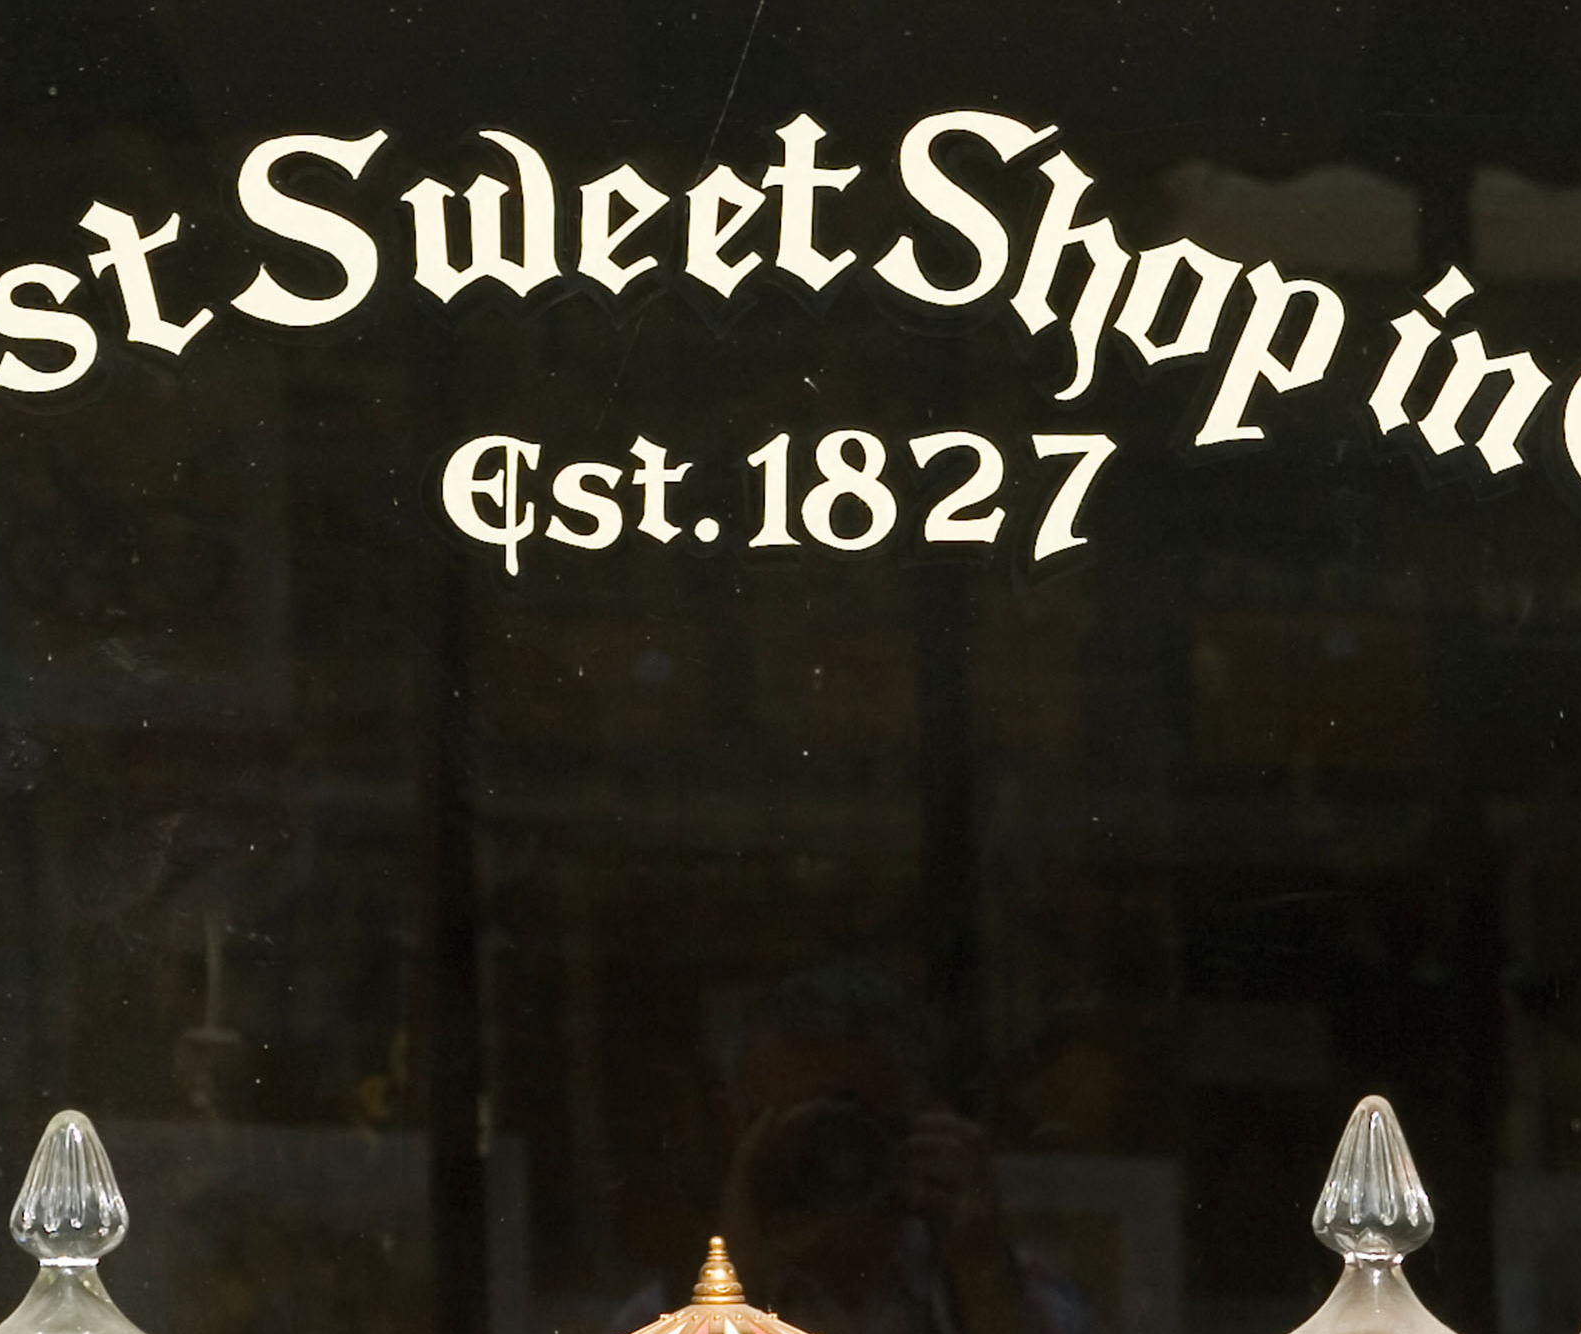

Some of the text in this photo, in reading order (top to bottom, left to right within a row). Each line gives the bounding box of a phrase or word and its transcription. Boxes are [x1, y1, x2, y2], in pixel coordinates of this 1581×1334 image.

[231, 114, 860, 325] Sweet
[874, 112, 1344, 445] Shop
[1369, 267, 1551, 473] in
[443, 431, 1116, 575] Est. 1827
